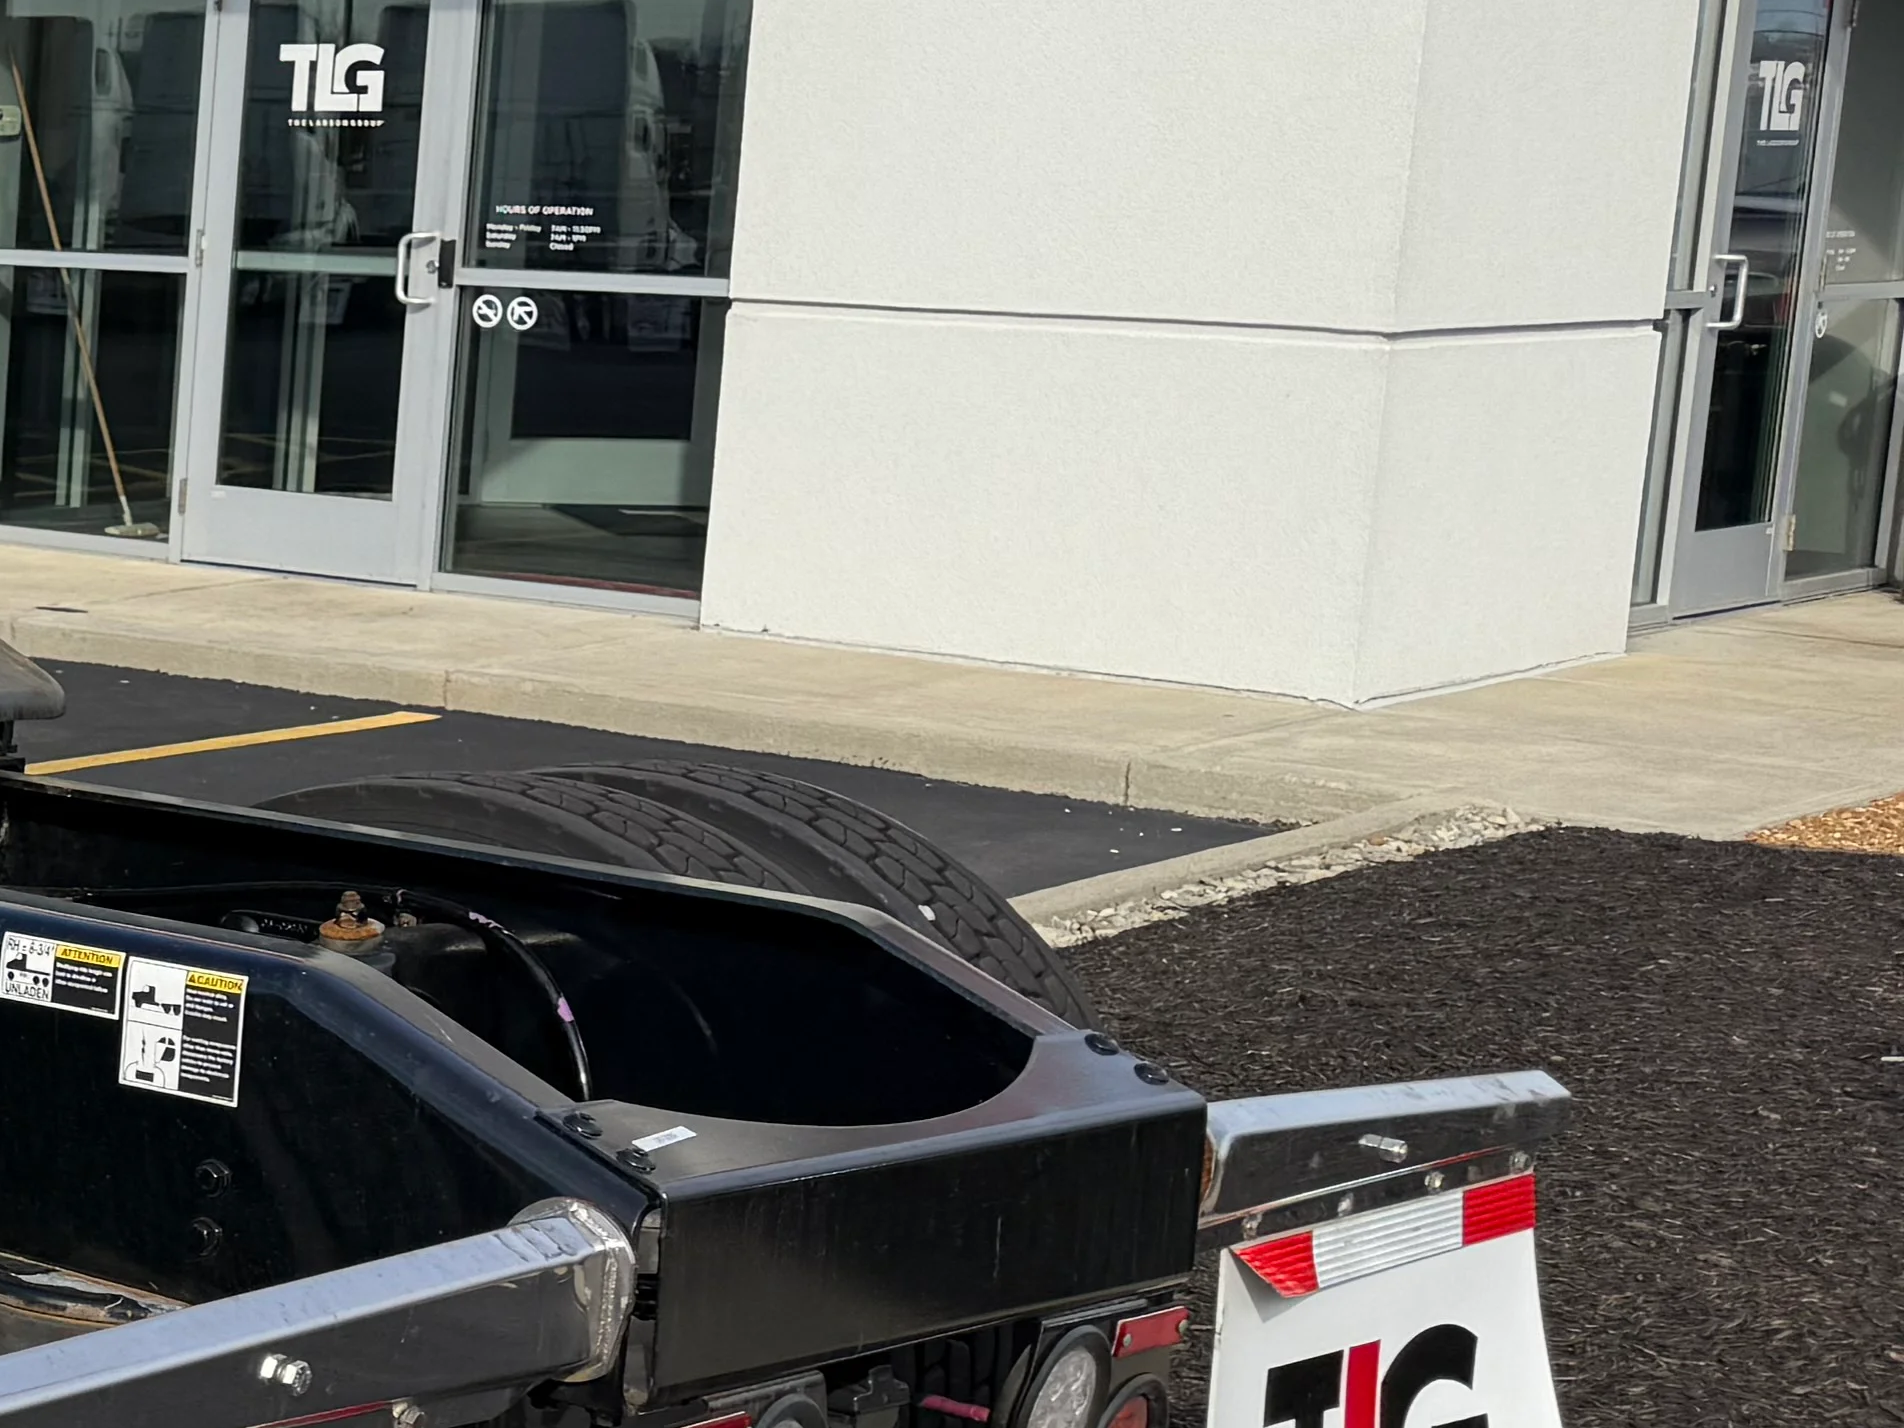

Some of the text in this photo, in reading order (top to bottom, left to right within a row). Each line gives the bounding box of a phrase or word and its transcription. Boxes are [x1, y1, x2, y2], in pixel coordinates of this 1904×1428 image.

[279, 43, 385, 112] TLG
[1759, 60, 1806, 131] TLG
[495, 205, 594, 216] HOURS OF OPERATION
[60, 947, 114, 965] ATTENTION
[4, 982, 50, 1000] UNLADEN
[196, 975, 243, 991] CAUTION
